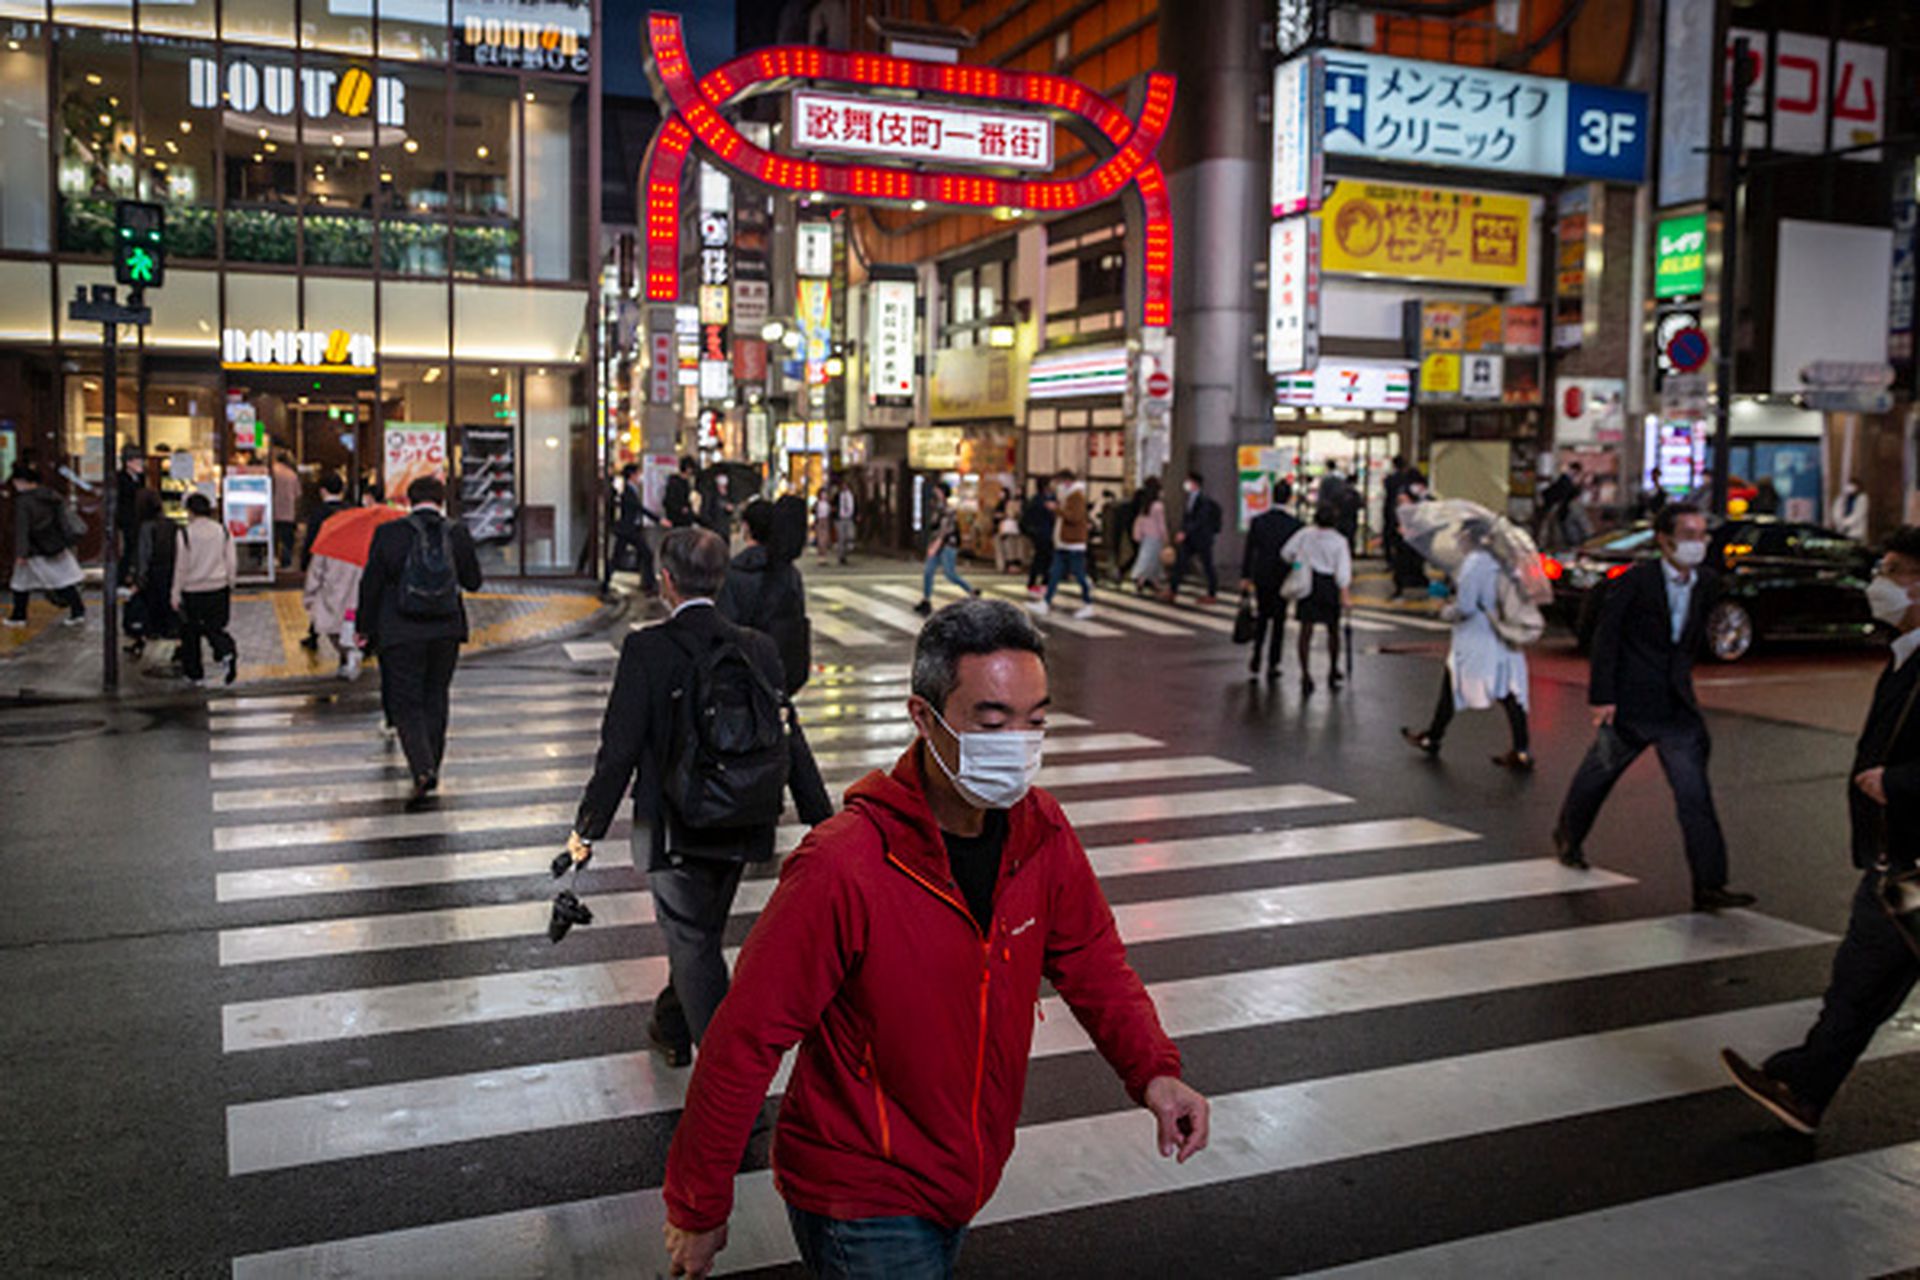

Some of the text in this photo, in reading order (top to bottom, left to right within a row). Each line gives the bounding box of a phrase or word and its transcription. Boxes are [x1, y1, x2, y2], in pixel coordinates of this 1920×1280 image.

[190, 58, 406, 127] DOUTOR
[1376, 68, 1549, 119] メンズライフ
[806, 103, 1042, 160] 歌舞伎町一番街
[1376, 114, 1516, 162] クリニック
[1578, 109, 1637, 157] 3F
